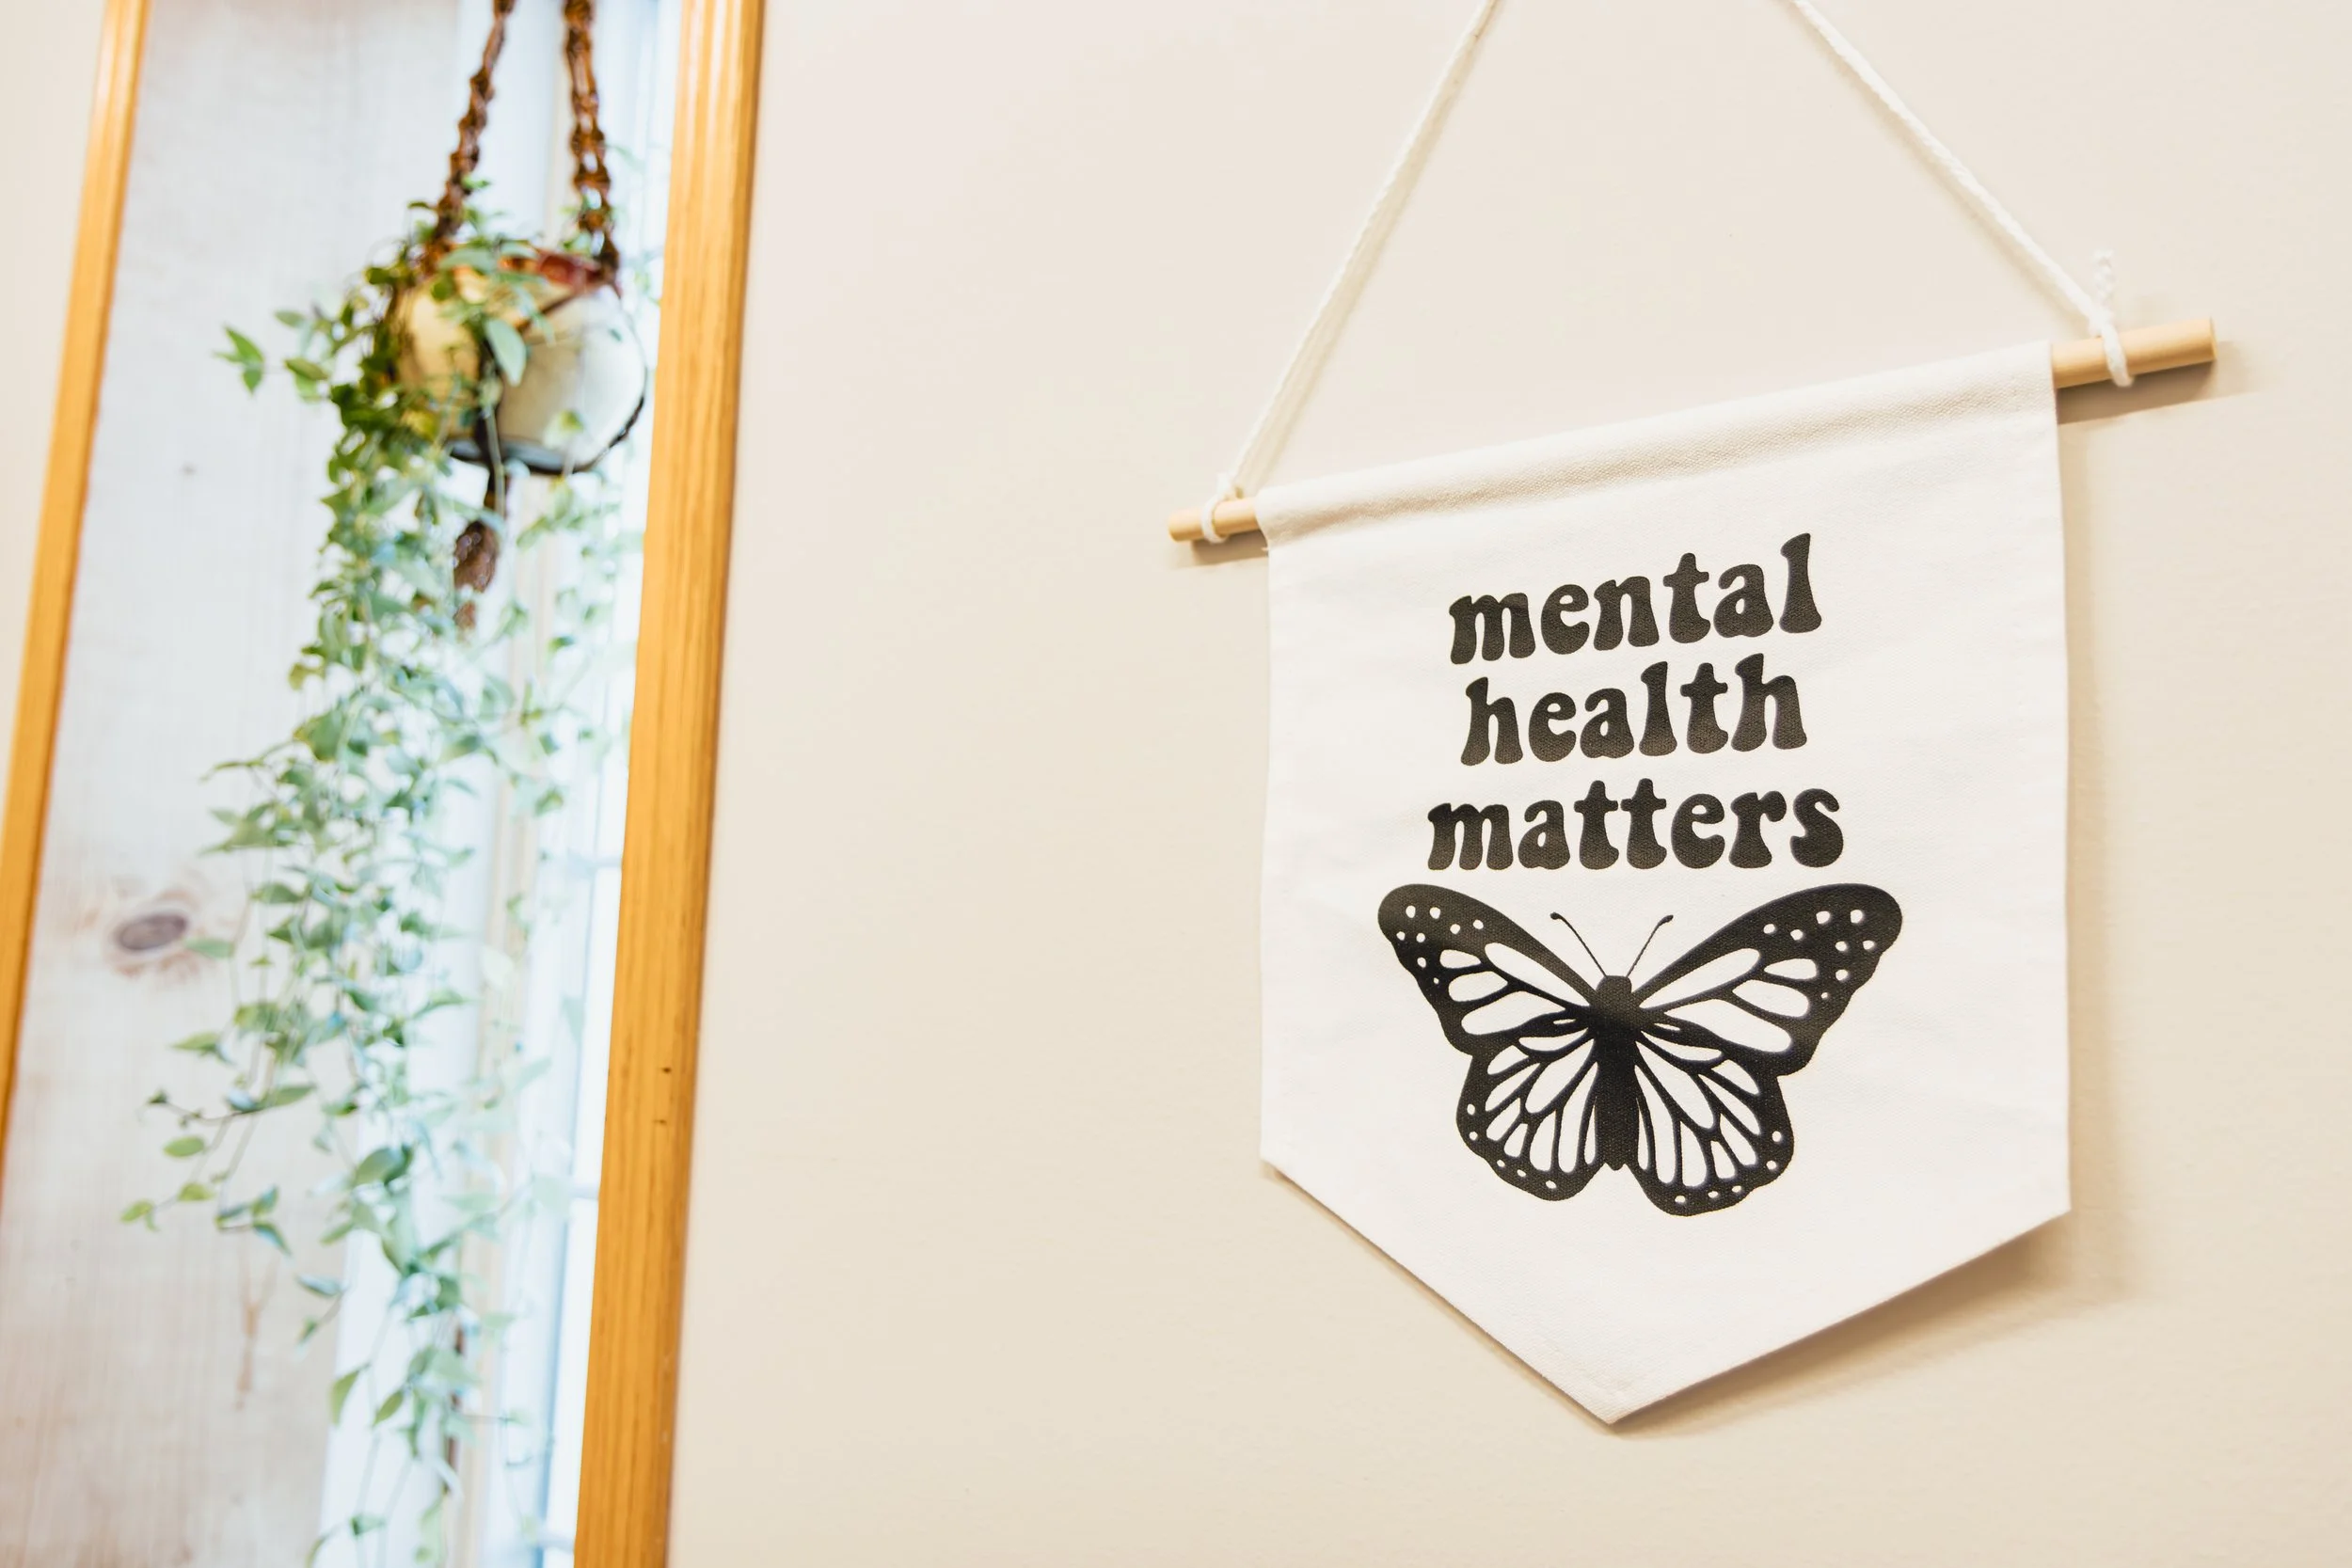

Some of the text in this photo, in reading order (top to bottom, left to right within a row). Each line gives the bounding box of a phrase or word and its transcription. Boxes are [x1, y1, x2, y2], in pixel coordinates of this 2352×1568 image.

[1448, 532, 1823, 665] mental
[1460, 653, 1807, 767] health
[1427, 778, 1844, 871] matters
